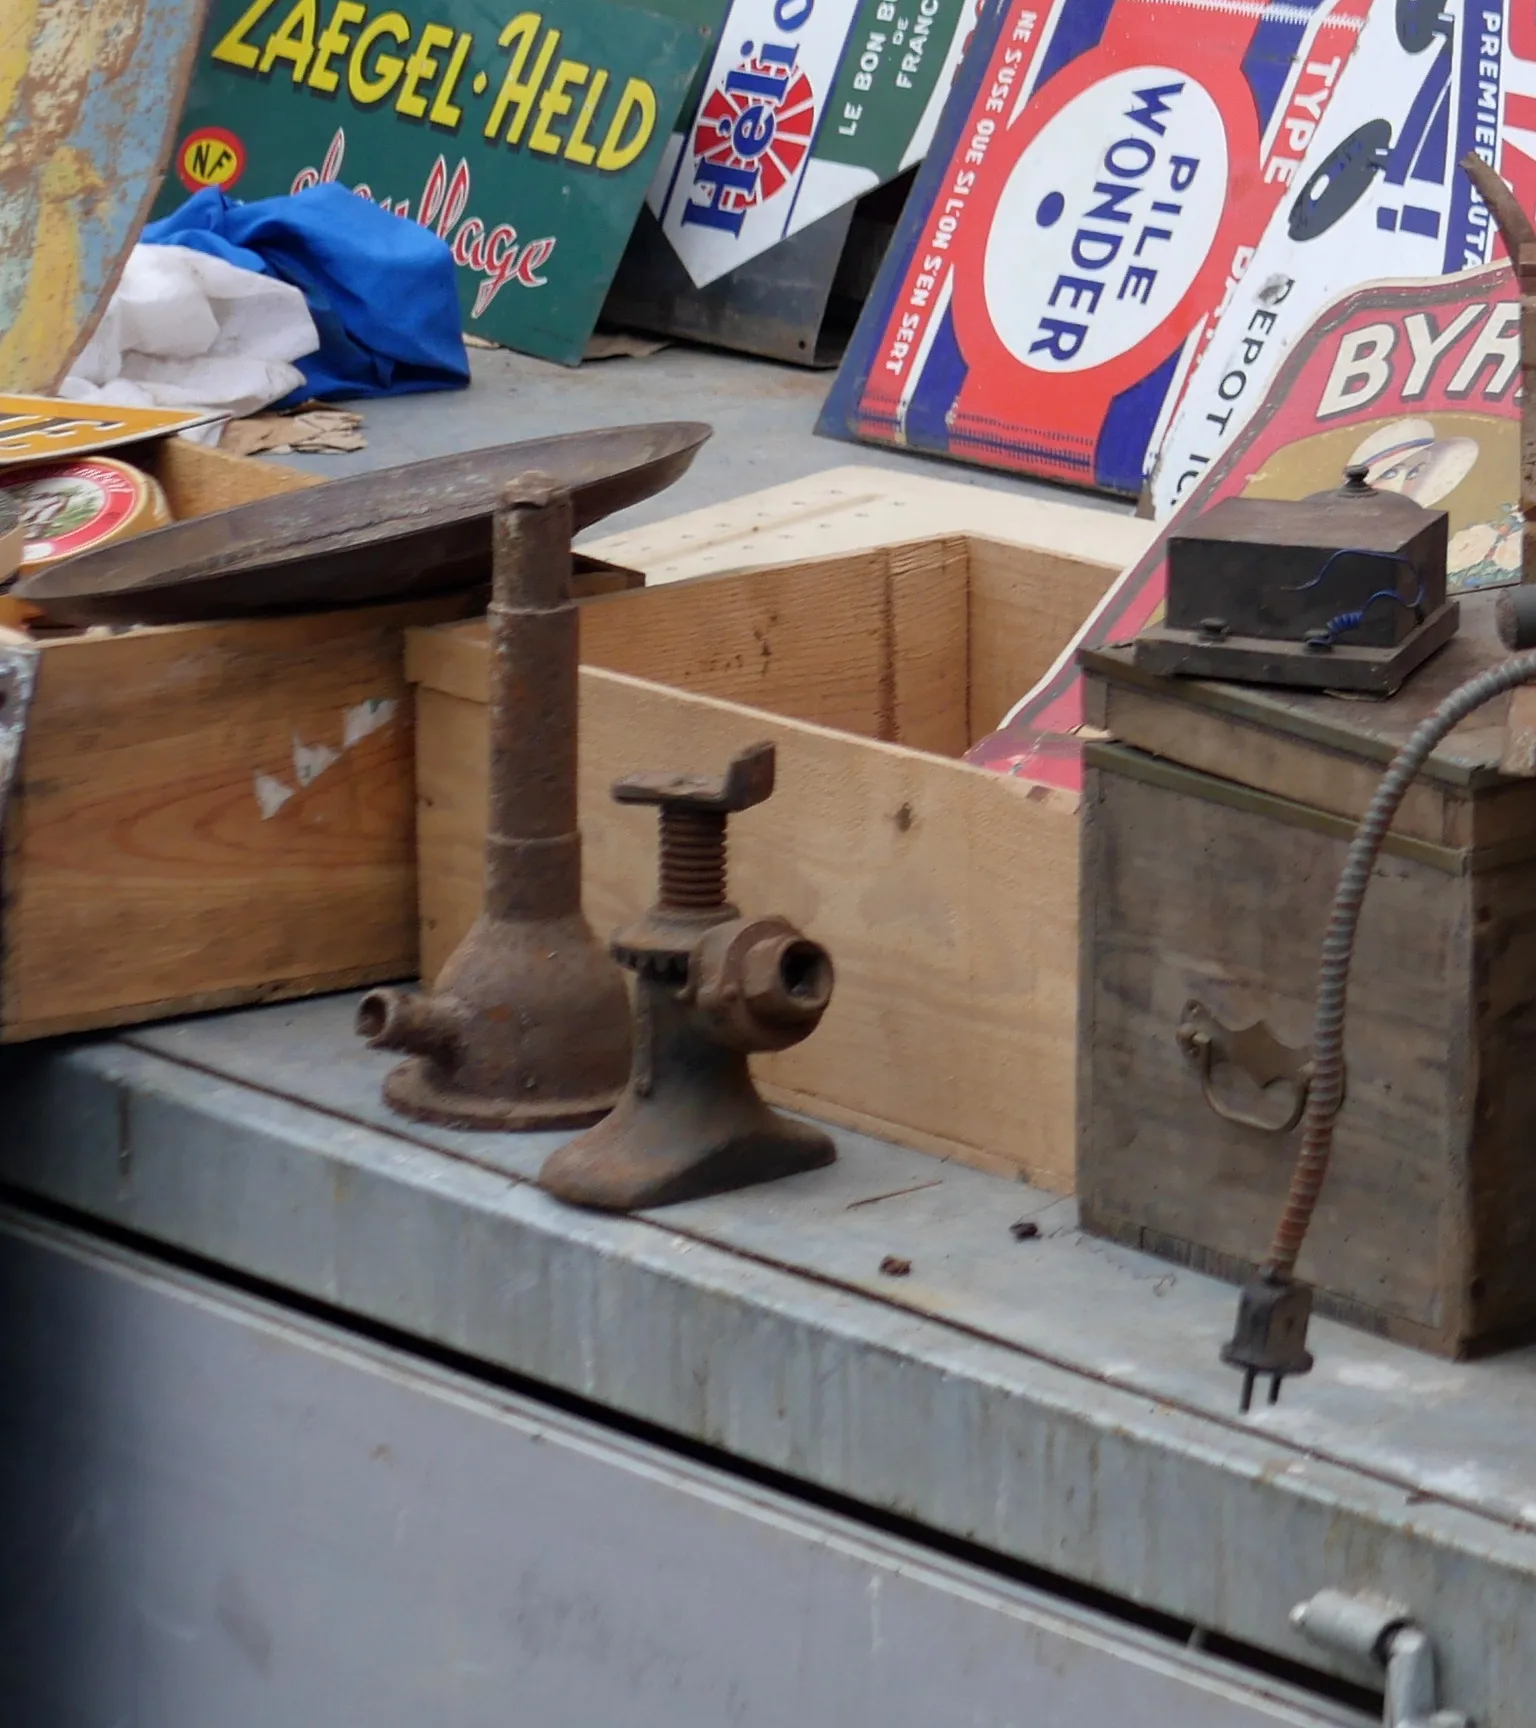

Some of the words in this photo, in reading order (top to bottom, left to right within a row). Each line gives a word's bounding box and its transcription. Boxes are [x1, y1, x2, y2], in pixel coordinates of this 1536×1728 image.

[893, 18, 908, 46] DE
[1012, 10, 1037, 43] NE
[838, 103, 862, 137] LE
[854, 29, 885, 89] BON
[965, 118, 996, 165] QUE
[1264, 56, 1340, 185] TYPE
[953, 170, 976, 196] SI
[1027, 81, 1185, 362] WONDER
[1118, 152, 1200, 306] PILE
[886, 312, 919, 375] SERT
[1316, 302, 1524, 418] BYR
[1171, 454, 1210, 506] IC
